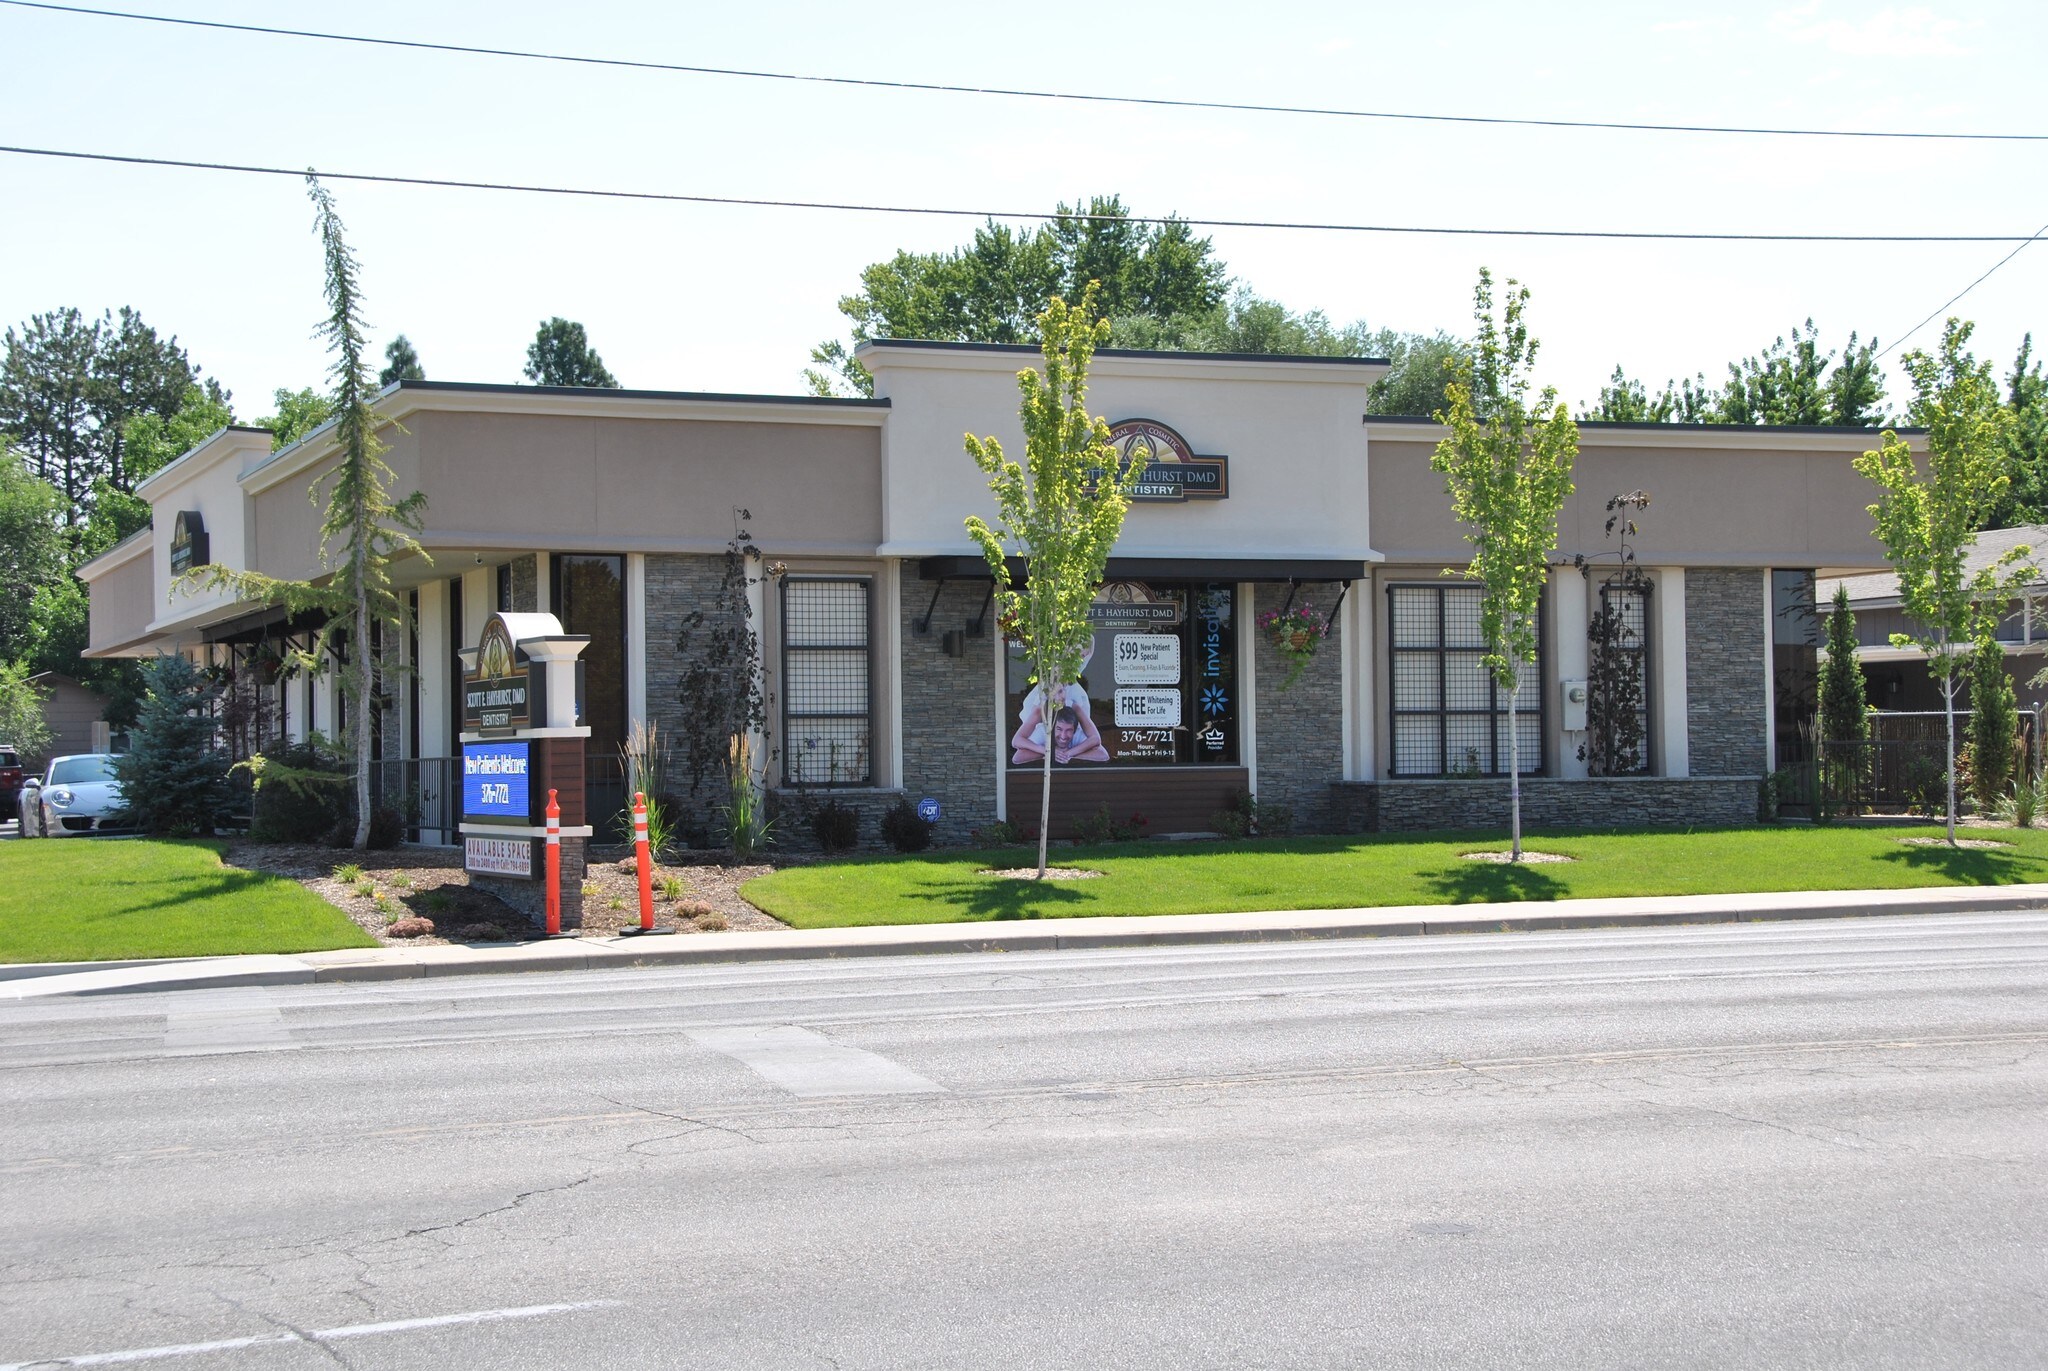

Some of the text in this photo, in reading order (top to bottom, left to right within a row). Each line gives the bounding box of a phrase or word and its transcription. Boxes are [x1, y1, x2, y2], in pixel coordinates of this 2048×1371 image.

[1103, 428, 1180, 450] ENERAL COSMETIC
[1119, 470, 1216, 483] HYHURST, DMD
[1117, 485, 1175, 495] ENTISTRY
[1153, 609, 1173, 617] DMD
[1120, 640, 1138, 662] $99
[1152, 643, 1171, 651] Patient
[1140, 652, 1159, 662] Special
[467, 692, 481, 708] SCOTT
[512, 688, 526, 704] DMD
[1121, 696, 1173, 715] FREE Whitening
[1147, 706, 1166, 714] For Life
[482, 713, 509, 726] DENTISTRY
[1121, 730, 1174, 742] 376-7721
[465, 754, 526, 774] New Patients Welcome
[481, 783, 509, 804] 376-7721
[468, 839, 530, 860] AVAILABLE SPACE
